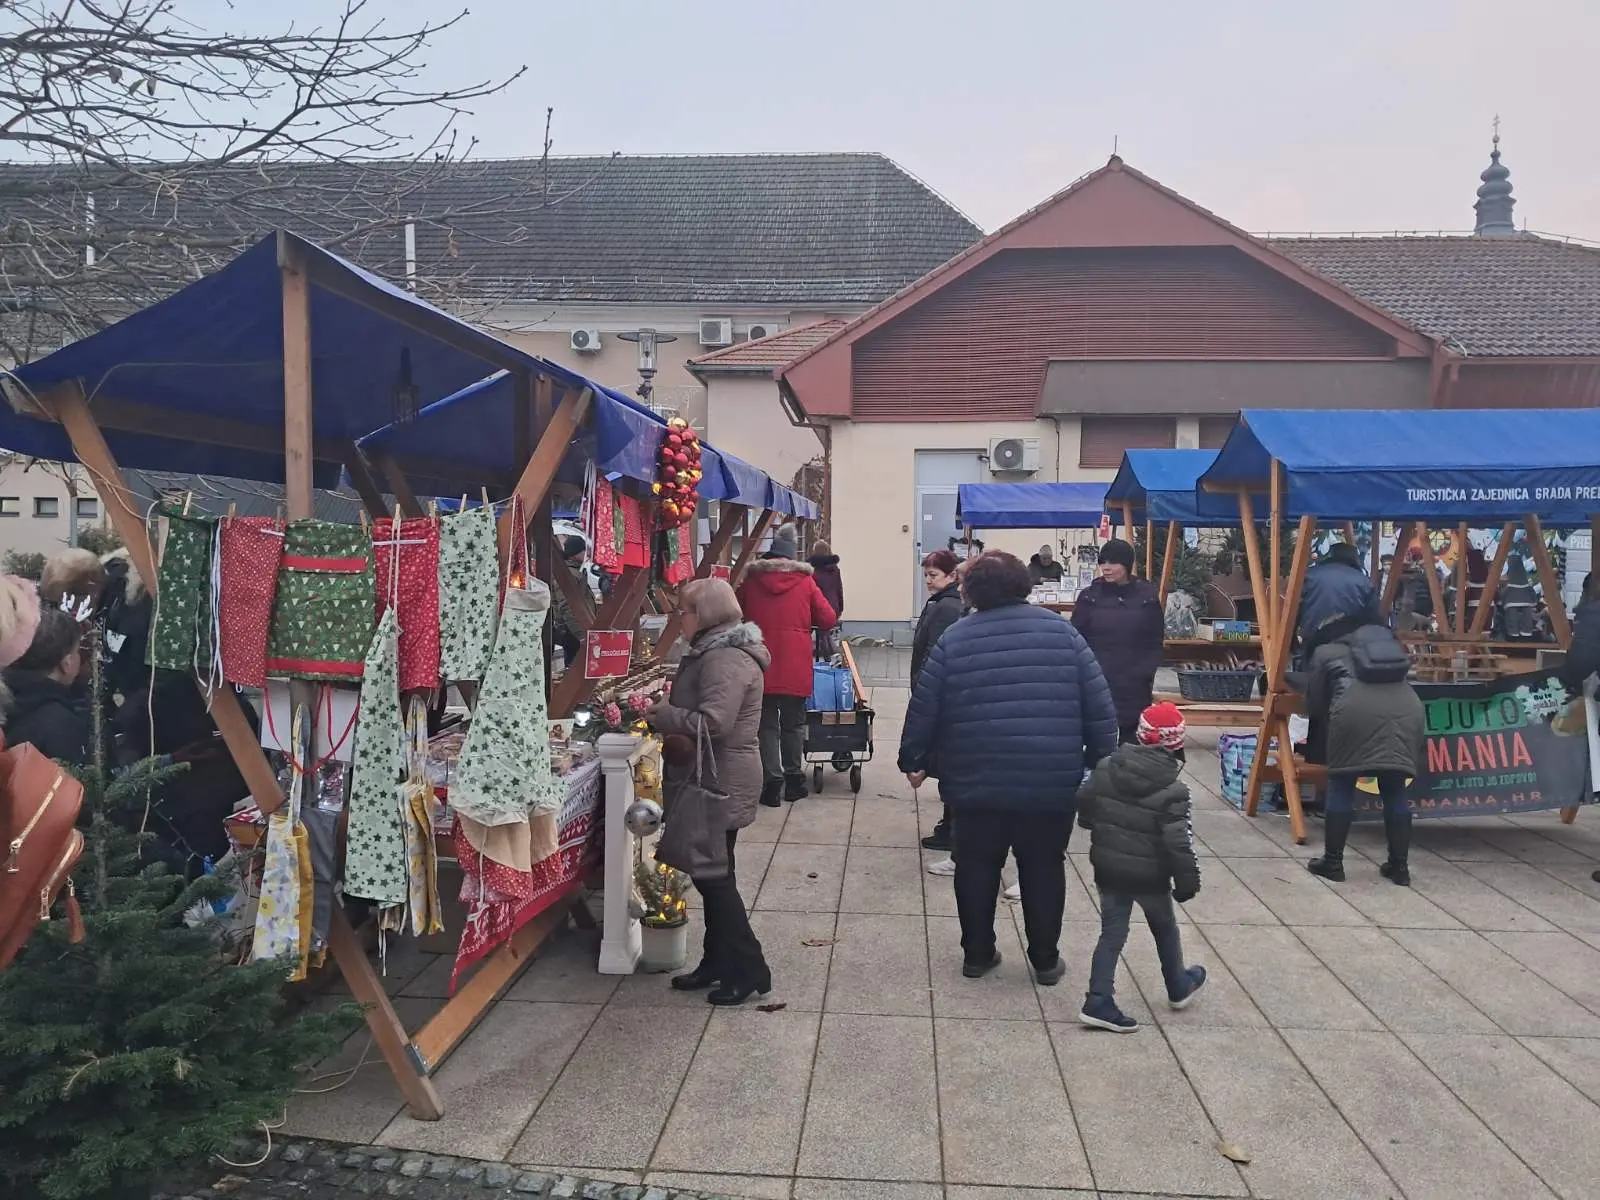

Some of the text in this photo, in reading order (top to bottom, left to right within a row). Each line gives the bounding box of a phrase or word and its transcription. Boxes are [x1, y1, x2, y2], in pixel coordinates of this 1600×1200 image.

[1406, 487, 1467, 501] TURISTIČKA
[1471, 487, 1529, 501] ZAJEDNICA
[1535, 486, 1572, 500] GRADA
[1425, 696, 1520, 731] LJUTO
[1426, 731, 1533, 773] MANIA
